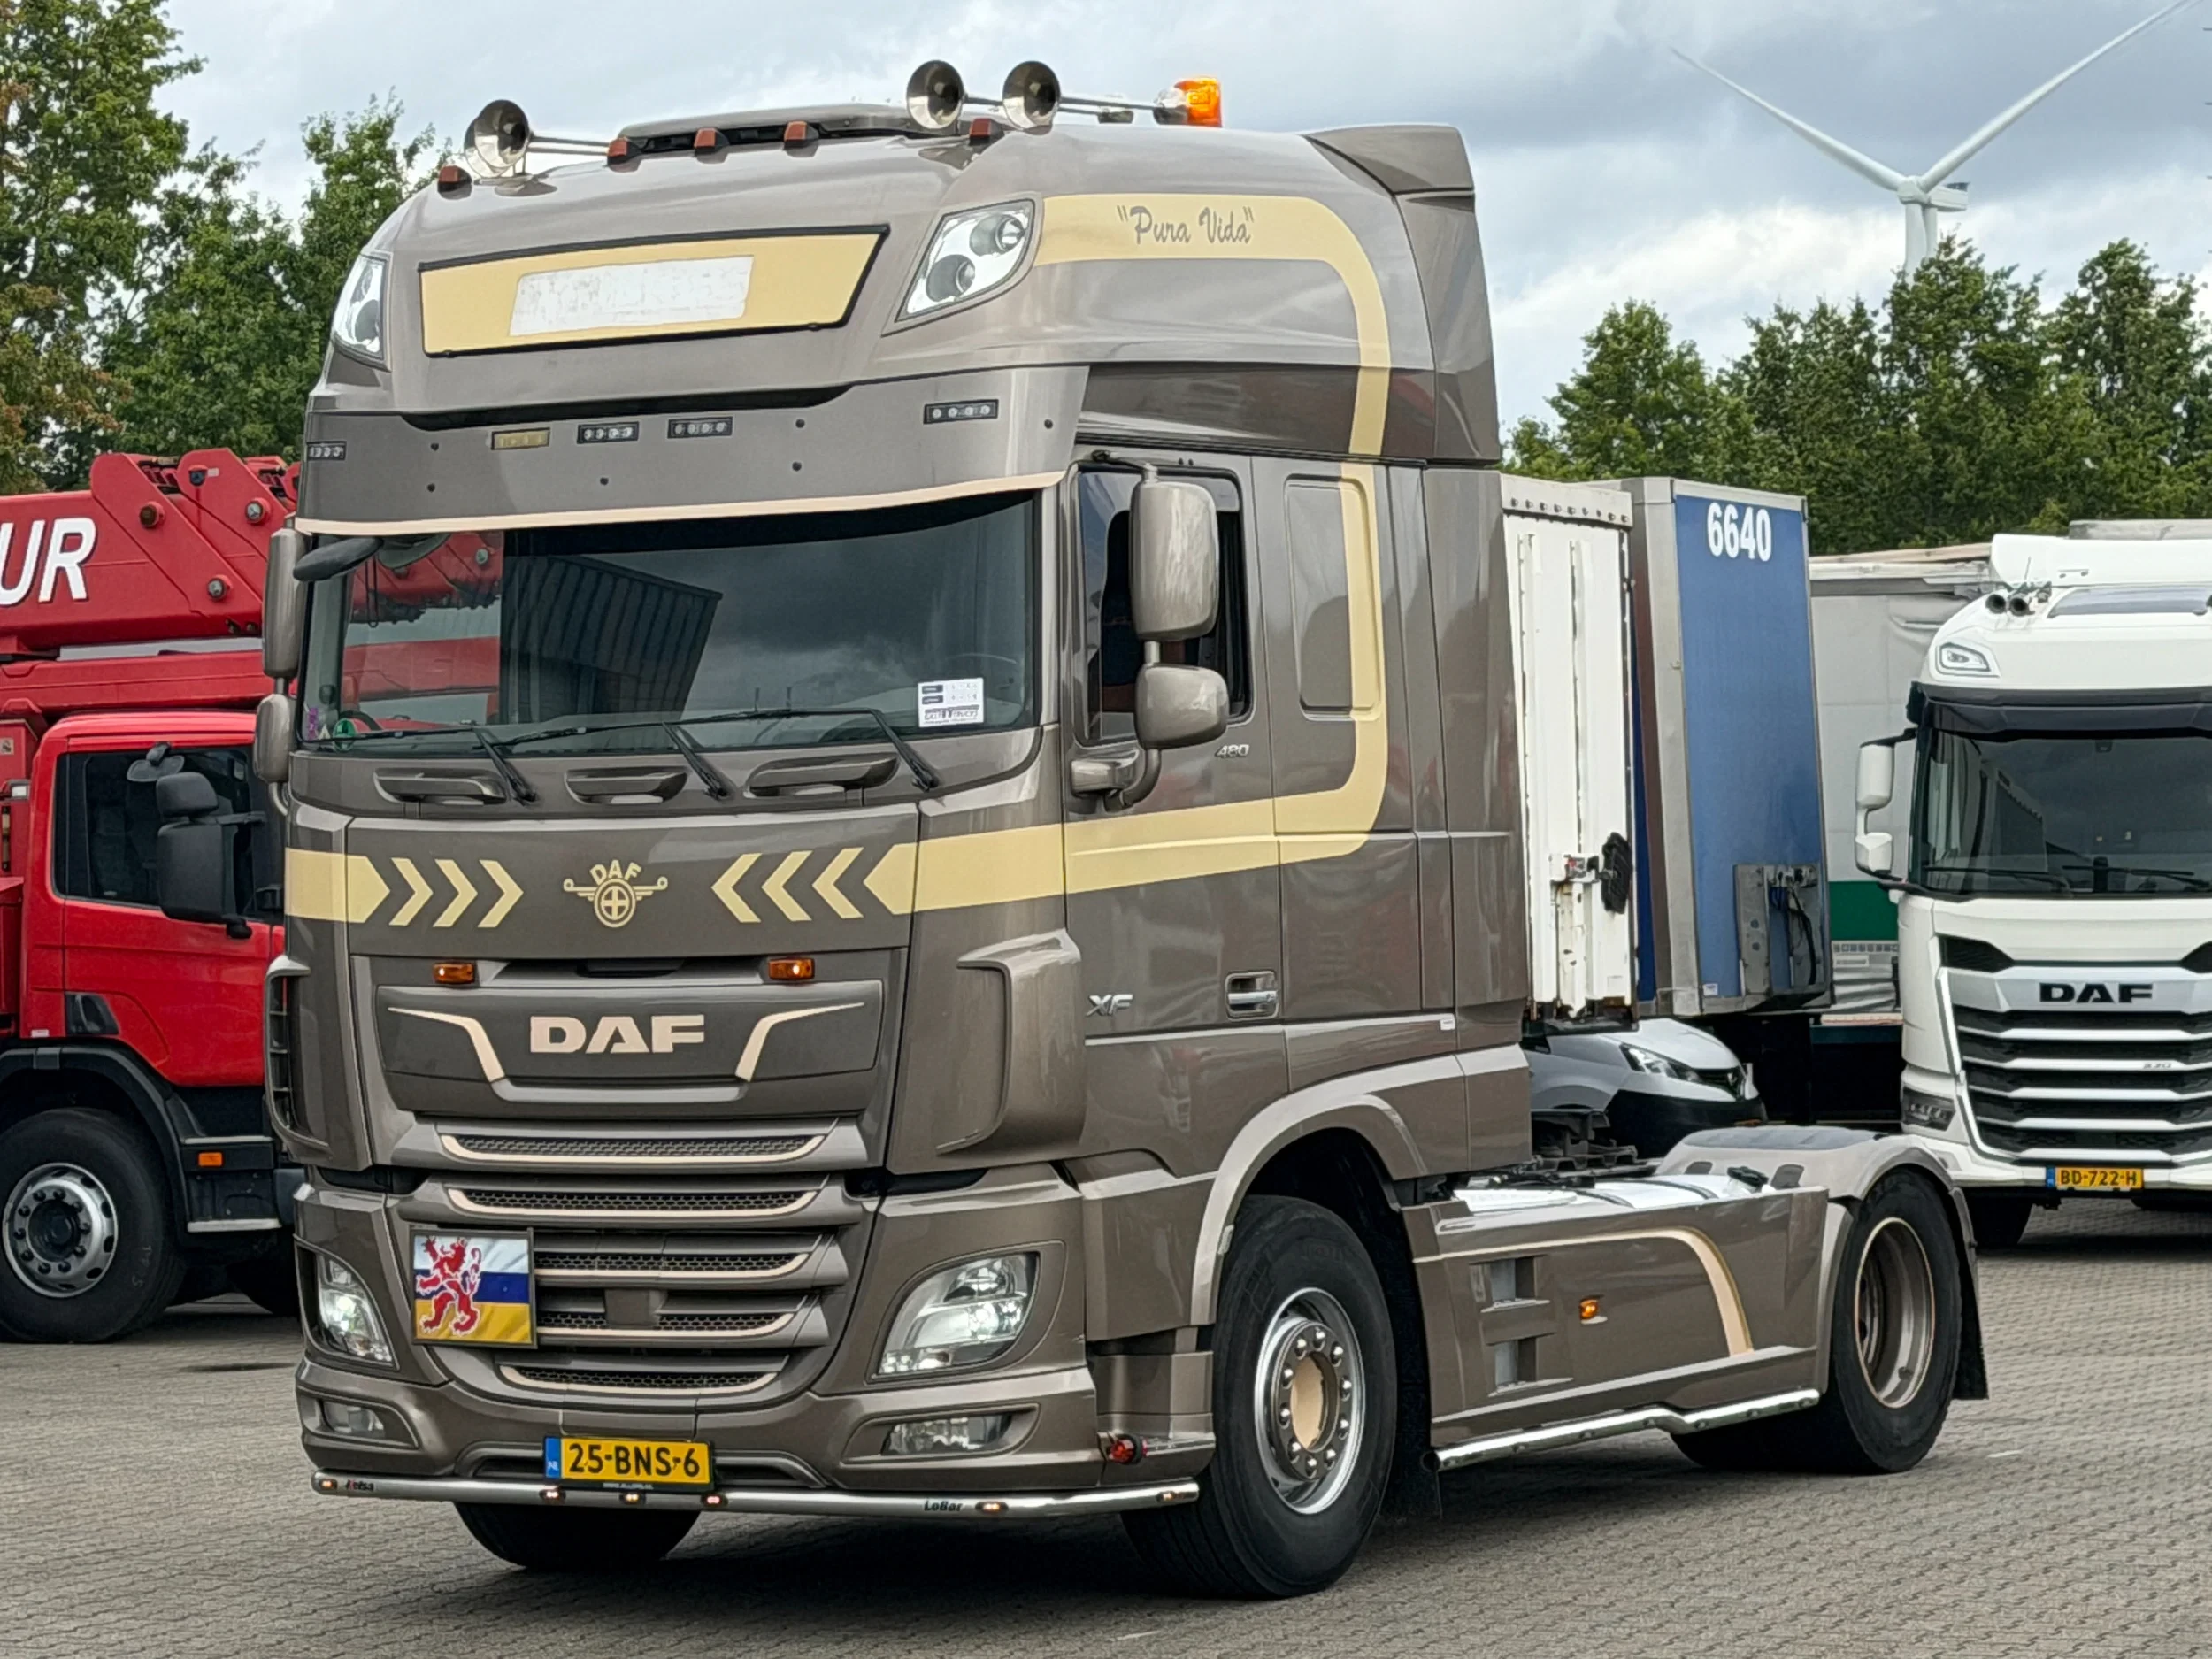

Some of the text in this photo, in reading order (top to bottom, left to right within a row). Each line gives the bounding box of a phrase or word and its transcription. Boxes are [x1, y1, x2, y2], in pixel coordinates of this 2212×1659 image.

[1707, 502, 1772, 562] 6640
[1215, 744, 1249, 758] 480
[589, 858, 642, 886] DAF
[2039, 982, 2153, 1003] DAF
[1086, 994, 1133, 1016] XF
[530, 1014, 704, 1054] DAF
[2060, 1169, 2138, 1187] BD-722-H
[568, 1442, 701, 1478] 25-BNS-6
[924, 1500, 963, 1512] LoBar
